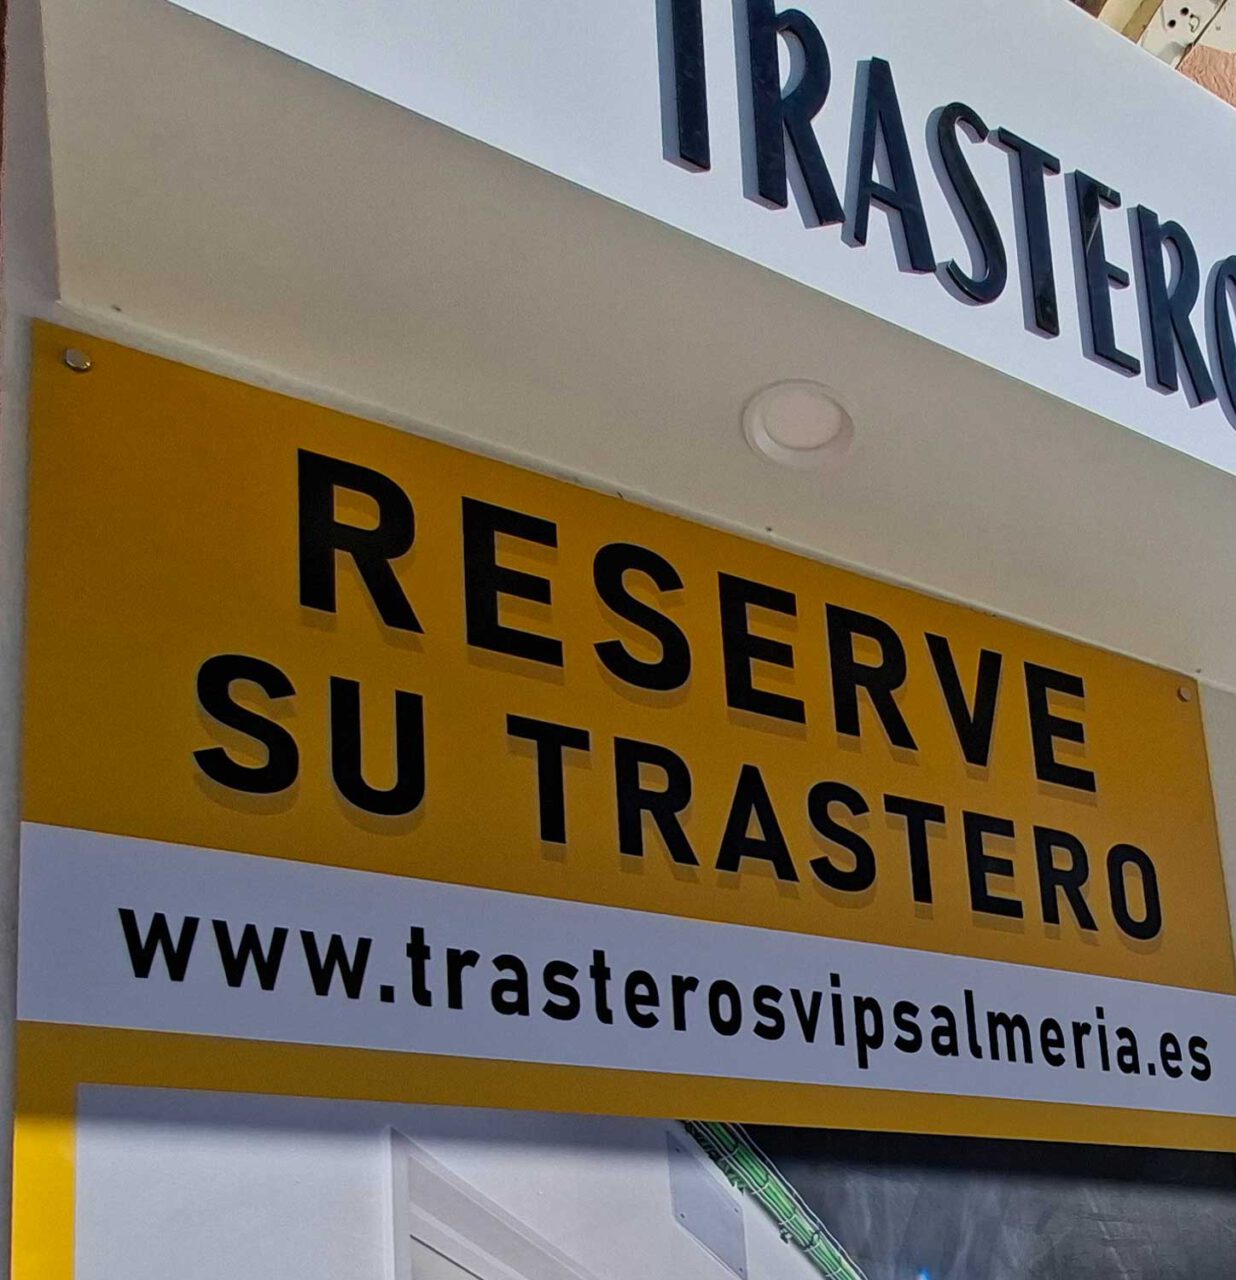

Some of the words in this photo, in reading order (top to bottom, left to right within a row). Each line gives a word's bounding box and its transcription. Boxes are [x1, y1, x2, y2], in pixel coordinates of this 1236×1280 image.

[297, 448, 1097, 793] RESERVE
[193, 653, 426, 817] SU
[506, 714, 1163, 942] TRASTERO
[117, 907, 1213, 1082] www.trasterosvipsalmeria.es
